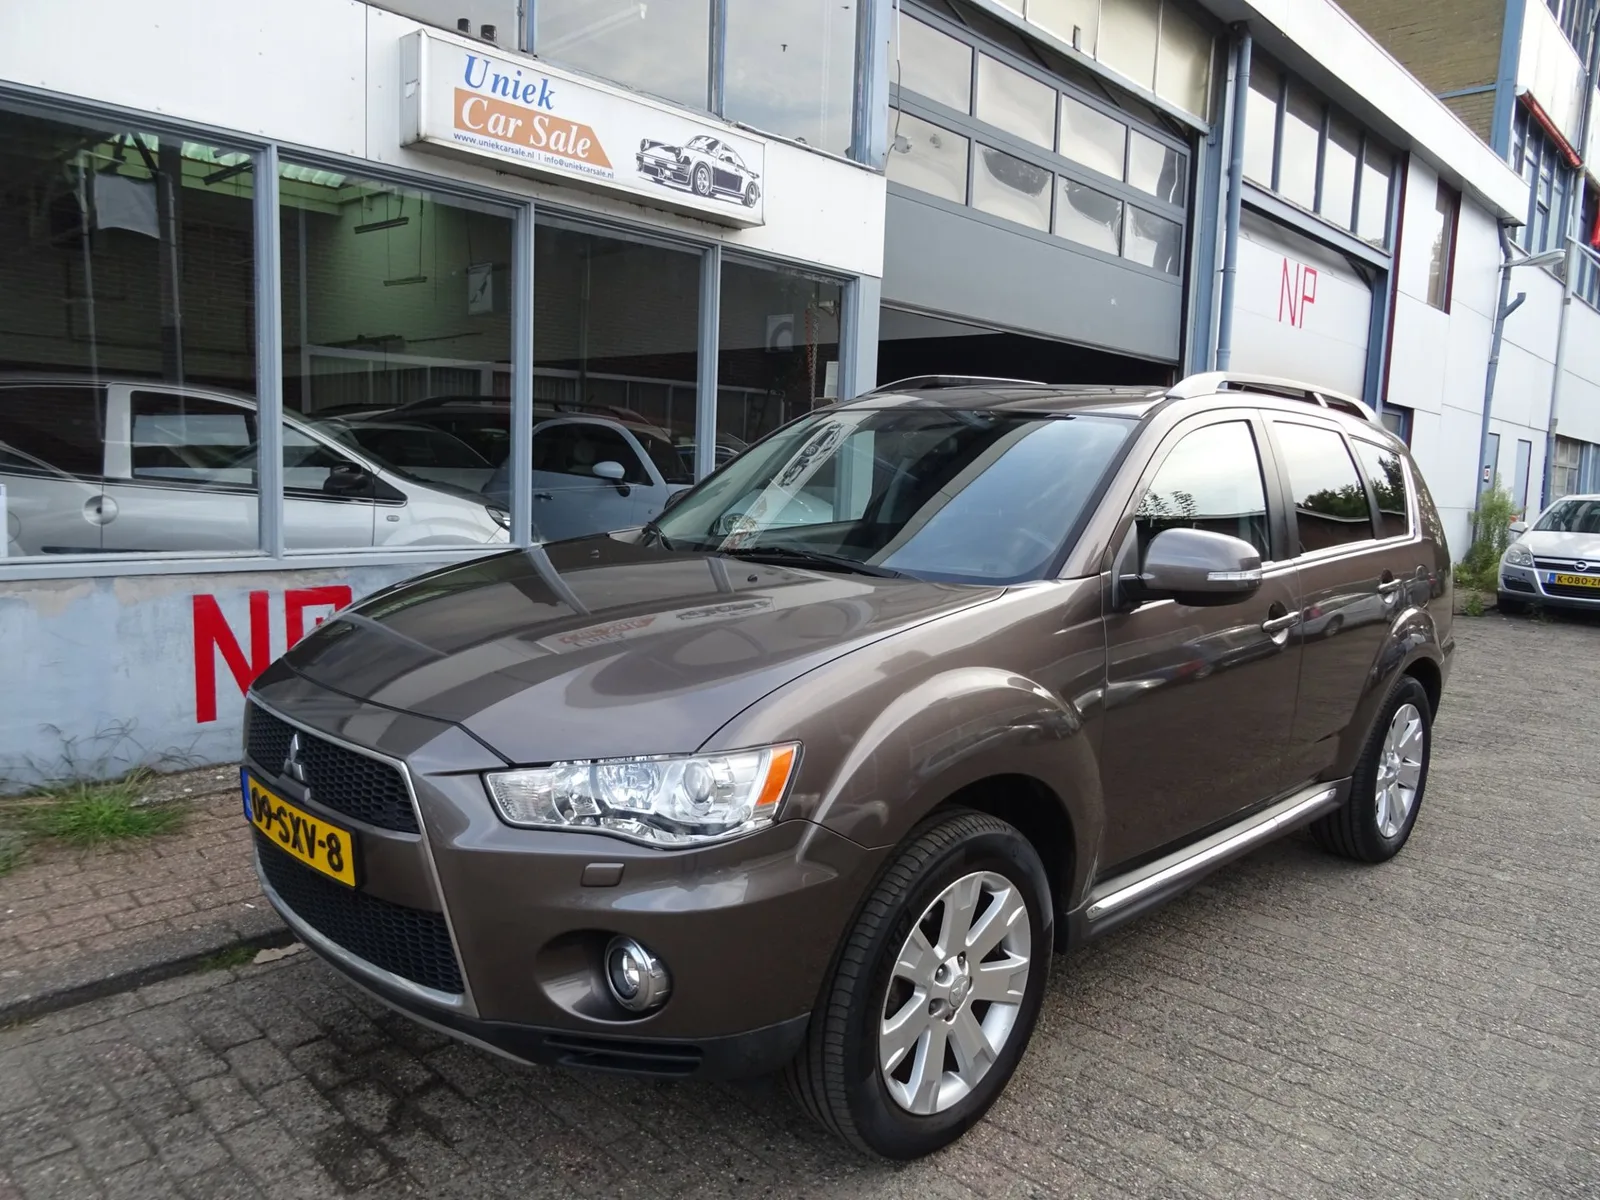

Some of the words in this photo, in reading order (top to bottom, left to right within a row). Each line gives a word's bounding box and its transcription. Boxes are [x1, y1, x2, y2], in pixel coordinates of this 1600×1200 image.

[464, 54, 556, 110] Uniek
[453, 132, 535, 160] www.uniekcarsale.nl
[544, 155, 614, 179] info@uniekcarsale.nl
[461, 97, 523, 138] Car
[529, 115, 591, 158] Sale
[1279, 257, 1317, 329] NP
[252, 787, 343, 872] 09-SXV-8
